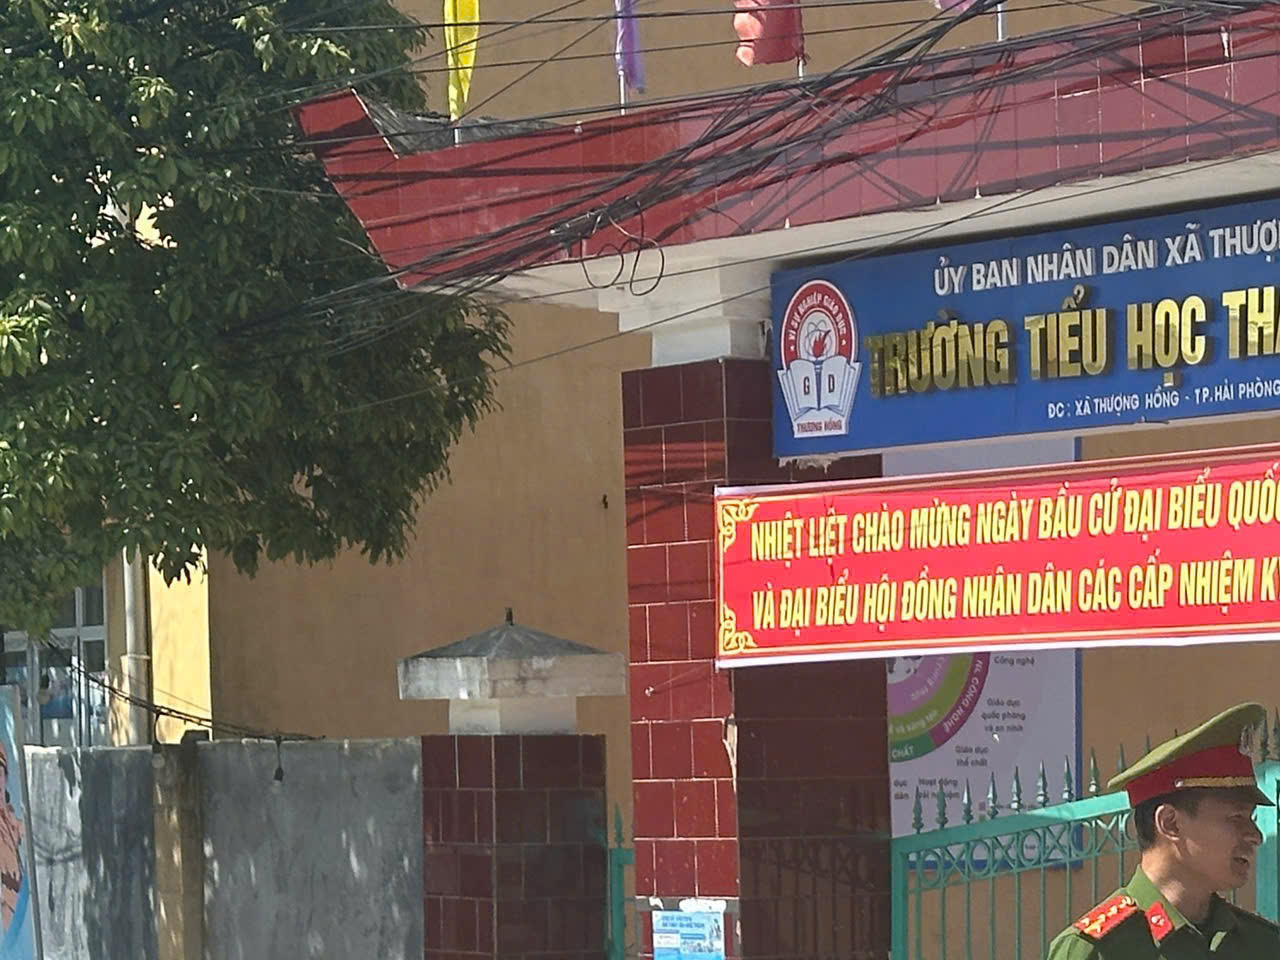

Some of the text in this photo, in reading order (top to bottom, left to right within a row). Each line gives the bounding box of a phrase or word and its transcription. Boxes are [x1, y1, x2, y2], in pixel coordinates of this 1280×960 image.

[934, 256, 966, 295] ỦY
[972, 257, 1018, 291] BAN
[1027, 243, 1093, 284] NHÂN
[1102, 233, 1155, 274] DÂN
[1165, 222, 1201, 266] XÃ
[864, 309, 1009, 396] TRƯỜNG
[1024, 284, 1107, 380] TIỂU
[1127, 296, 1206, 387] HỌC
[803, 374, 835, 396] G D
[1094, 393, 1139, 416] THƯỢNG
[1145, 386, 1179, 409] HỒNG
[751, 511, 803, 567] NHIỆT
[809, 507, 846, 565] LIỆT
[852, 503, 904, 553] CHÀO
[910, 498, 969, 549] MỪNG
[976, 491, 1031, 544] NGÀY
[1038, 481, 1083, 540] BẦU
[1088, 476, 1122, 535] CỬ
[1123, 489, 1161, 541] ĐẠI
[1168, 467, 1222, 528] BIỂU
[753, 582, 776, 630] VÀ
[779, 588, 810, 636] ĐẠI
[816, 568, 859, 626] BIỂU
[864, 574, 898, 631] HỘI
[901, 565, 957, 621] ĐỒNG
[962, 565, 1021, 618] NHÂN
[1027, 562, 1074, 614] DÂN
[1078, 558, 1121, 611] CÁC
[1127, 548, 1172, 609] CẤP
[1179, 550, 1253, 614] NHIỆM
